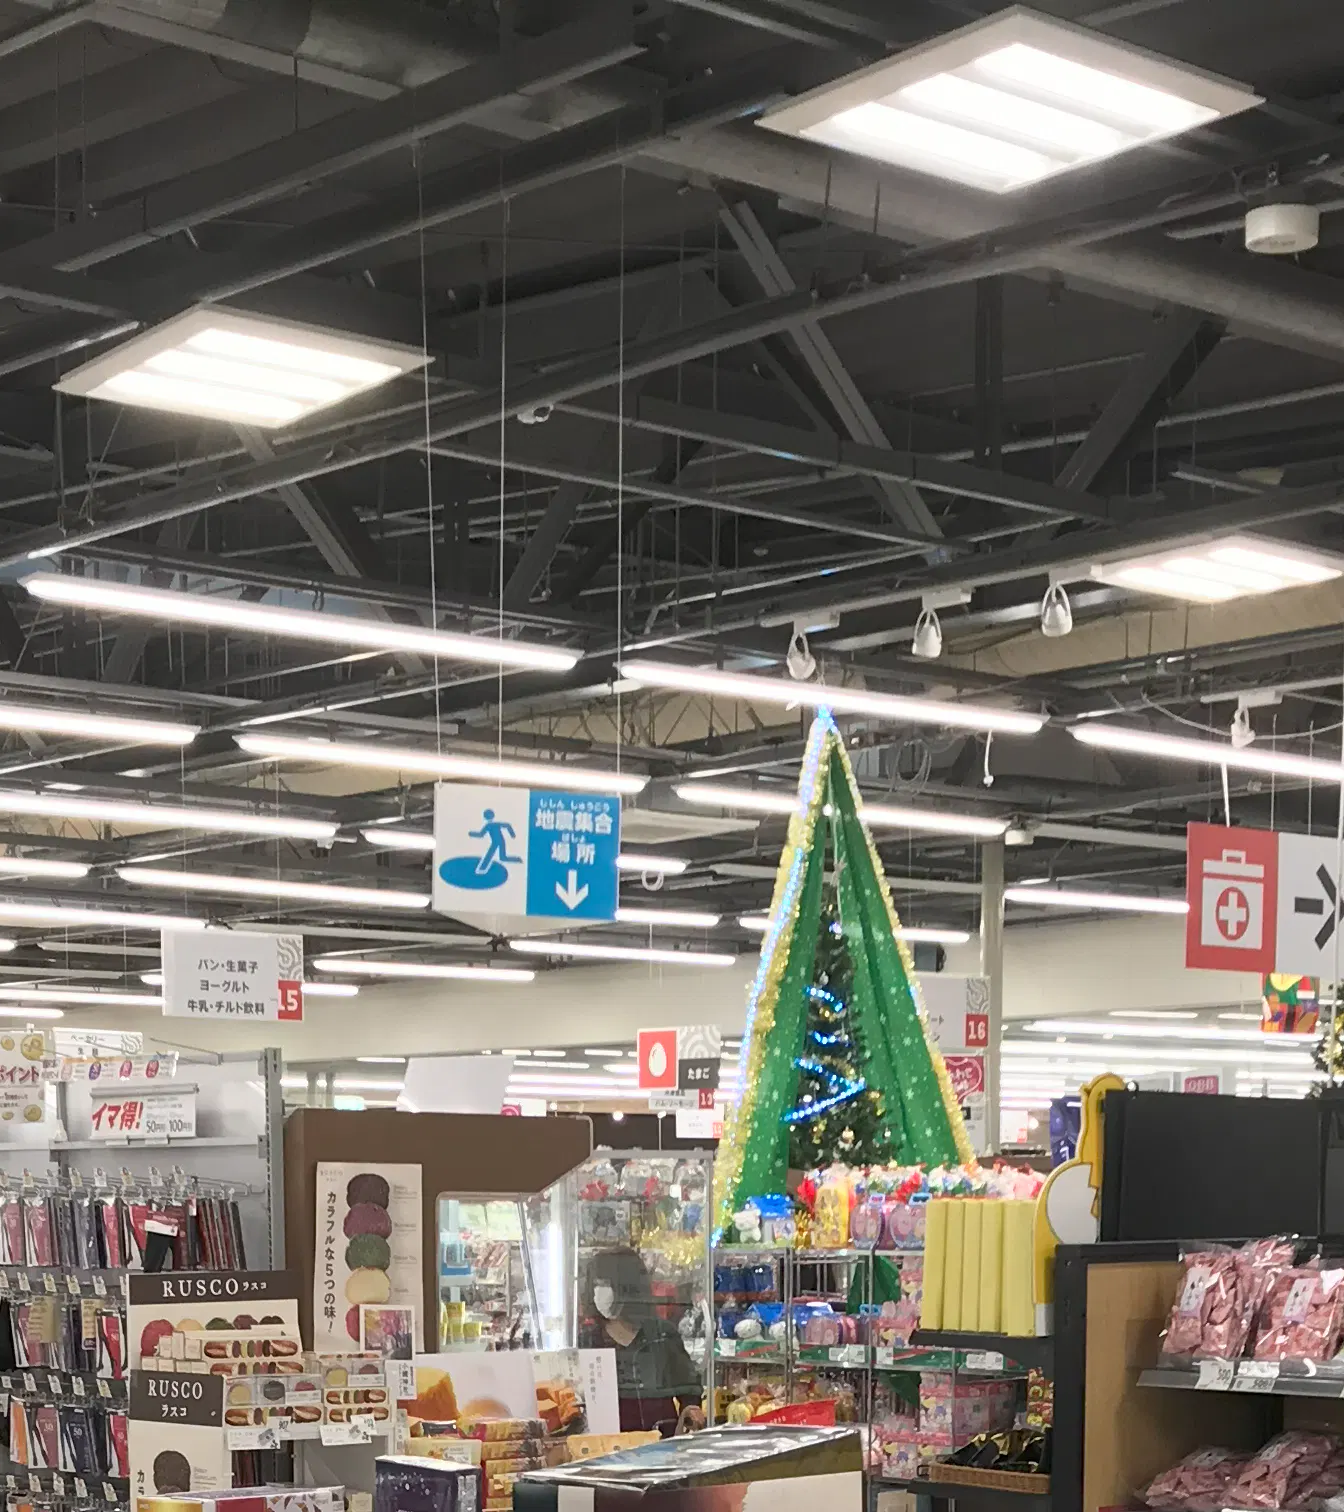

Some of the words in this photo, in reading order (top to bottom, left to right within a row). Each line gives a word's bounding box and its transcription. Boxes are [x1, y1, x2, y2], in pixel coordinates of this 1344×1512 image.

[535, 809, 613, 835] 地震集合
[551, 842, 596, 865] 場所
[198, 959, 258, 974] パン・生菓子
[200, 979, 249, 992] ヨーグルト
[968, 1020, 986, 1040] 16
[92, 1101, 144, 1131] イマ得!
[323, 1191, 337, 1333] カラフルな5つの味!
[162, 1277, 239, 1298] RUSCO
[243, 1280, 268, 1291] ラスコ
[148, 1379, 203, 1399] RUSCO
[161, 1404, 188, 1417] ラスコ
